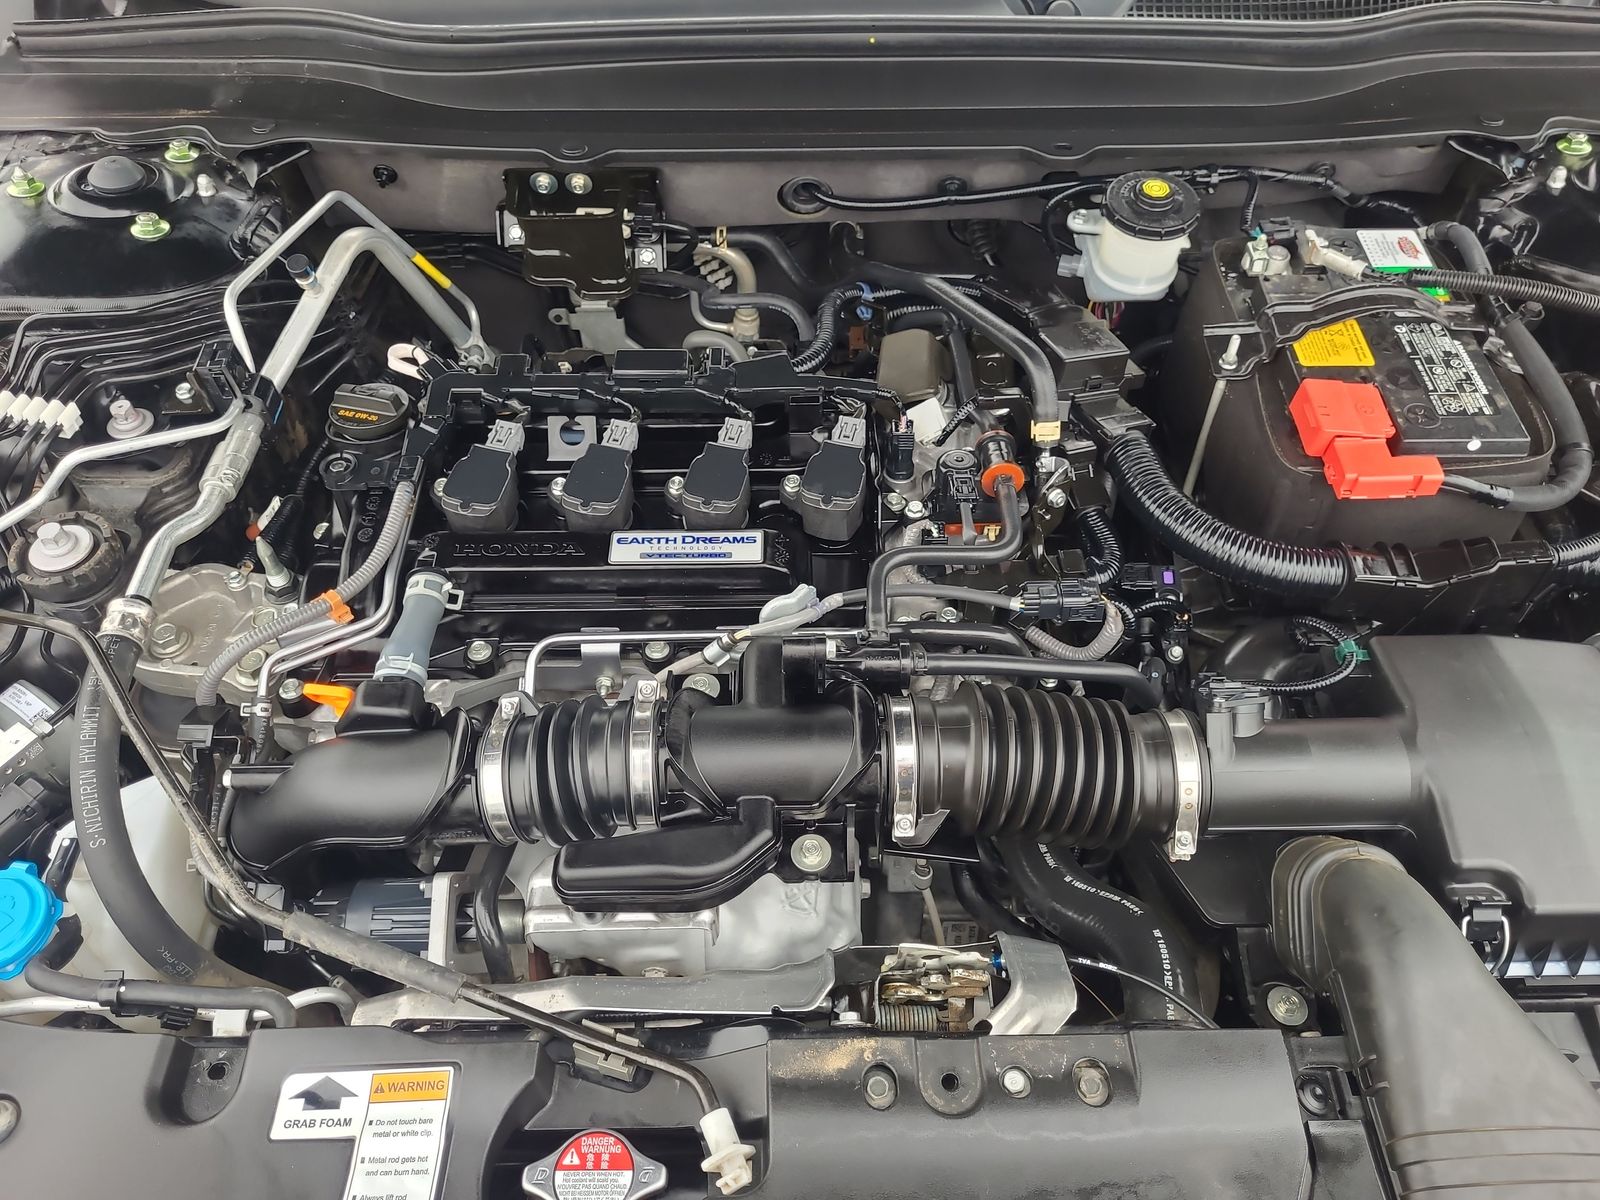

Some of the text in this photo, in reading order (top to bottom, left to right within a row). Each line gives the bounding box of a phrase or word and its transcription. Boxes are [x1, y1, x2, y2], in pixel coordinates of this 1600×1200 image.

[338, 409, 378, 421] SAE 0W-20
[616, 535, 757, 545] EARTH DREAMS
[453, 542, 586, 556] HONDA
[79, 705, 101, 765] HYLAMMIT
[387, 1080, 445, 1093] WARNING
[283, 1117, 353, 1129] GRAB FOAM
[399, 1118, 418, 1126] touch
[419, 1117, 434, 1125] bare
[372, 1130, 392, 1138] metal
[400, 1129, 419, 1137] white
[420, 1129, 434, 1139] clip.
[581, 1136, 615, 1146] DANGER
[581, 1144, 622, 1154] WARNUNG
[367, 1155, 429, 1165] Metal rod gets hot
[393, 1168, 410, 1176] burn
